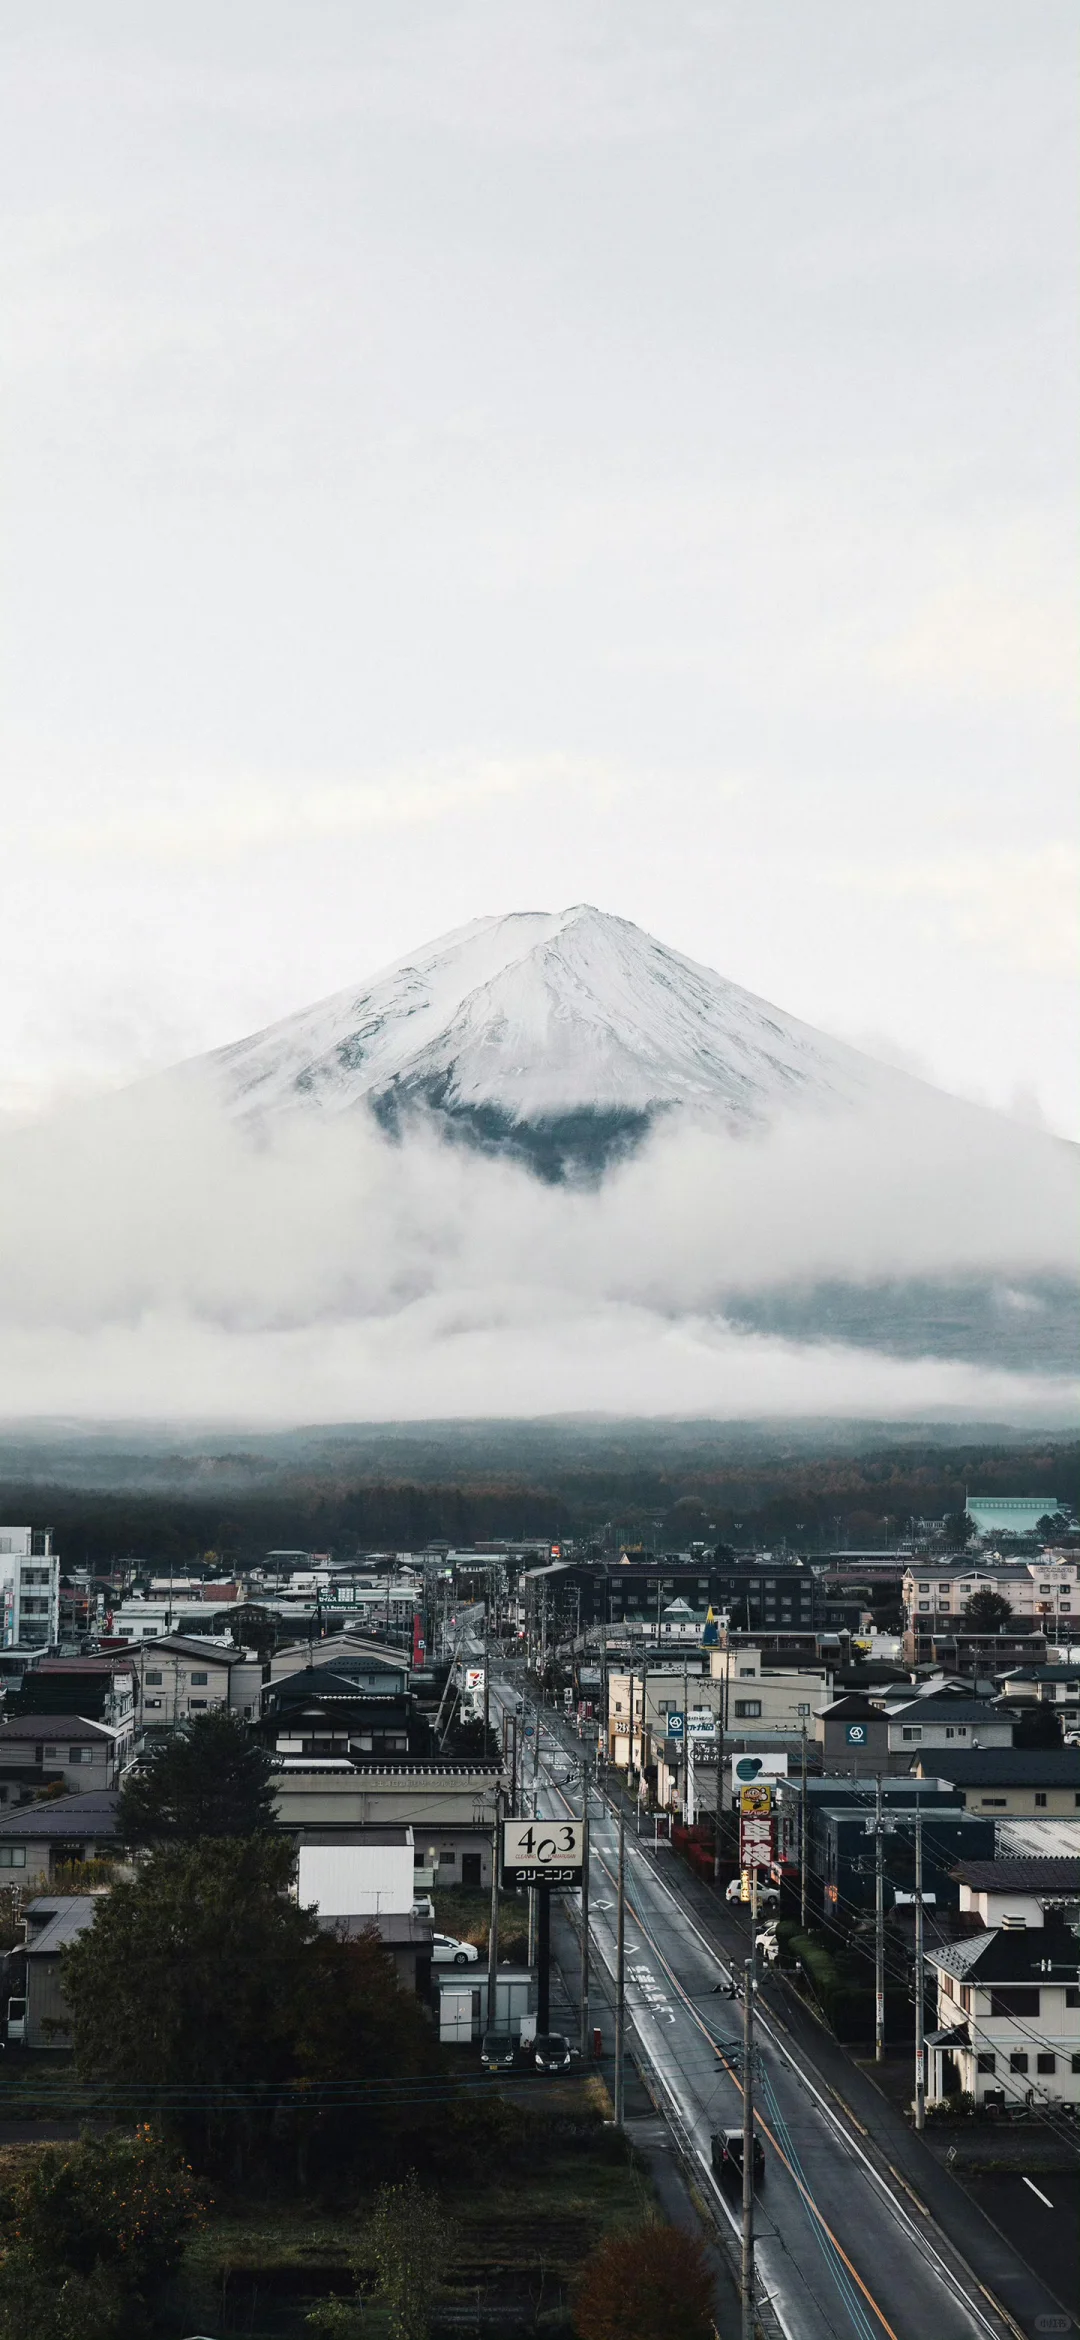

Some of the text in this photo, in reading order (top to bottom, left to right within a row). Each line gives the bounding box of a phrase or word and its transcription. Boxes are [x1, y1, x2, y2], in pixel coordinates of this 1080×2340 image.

[418, 1639, 425, 1649] P
[517, 1825, 576, 1864] 403
[742, 1819, 773, 1868] 車検
[515, 1869, 576, 1881] クリーニング
